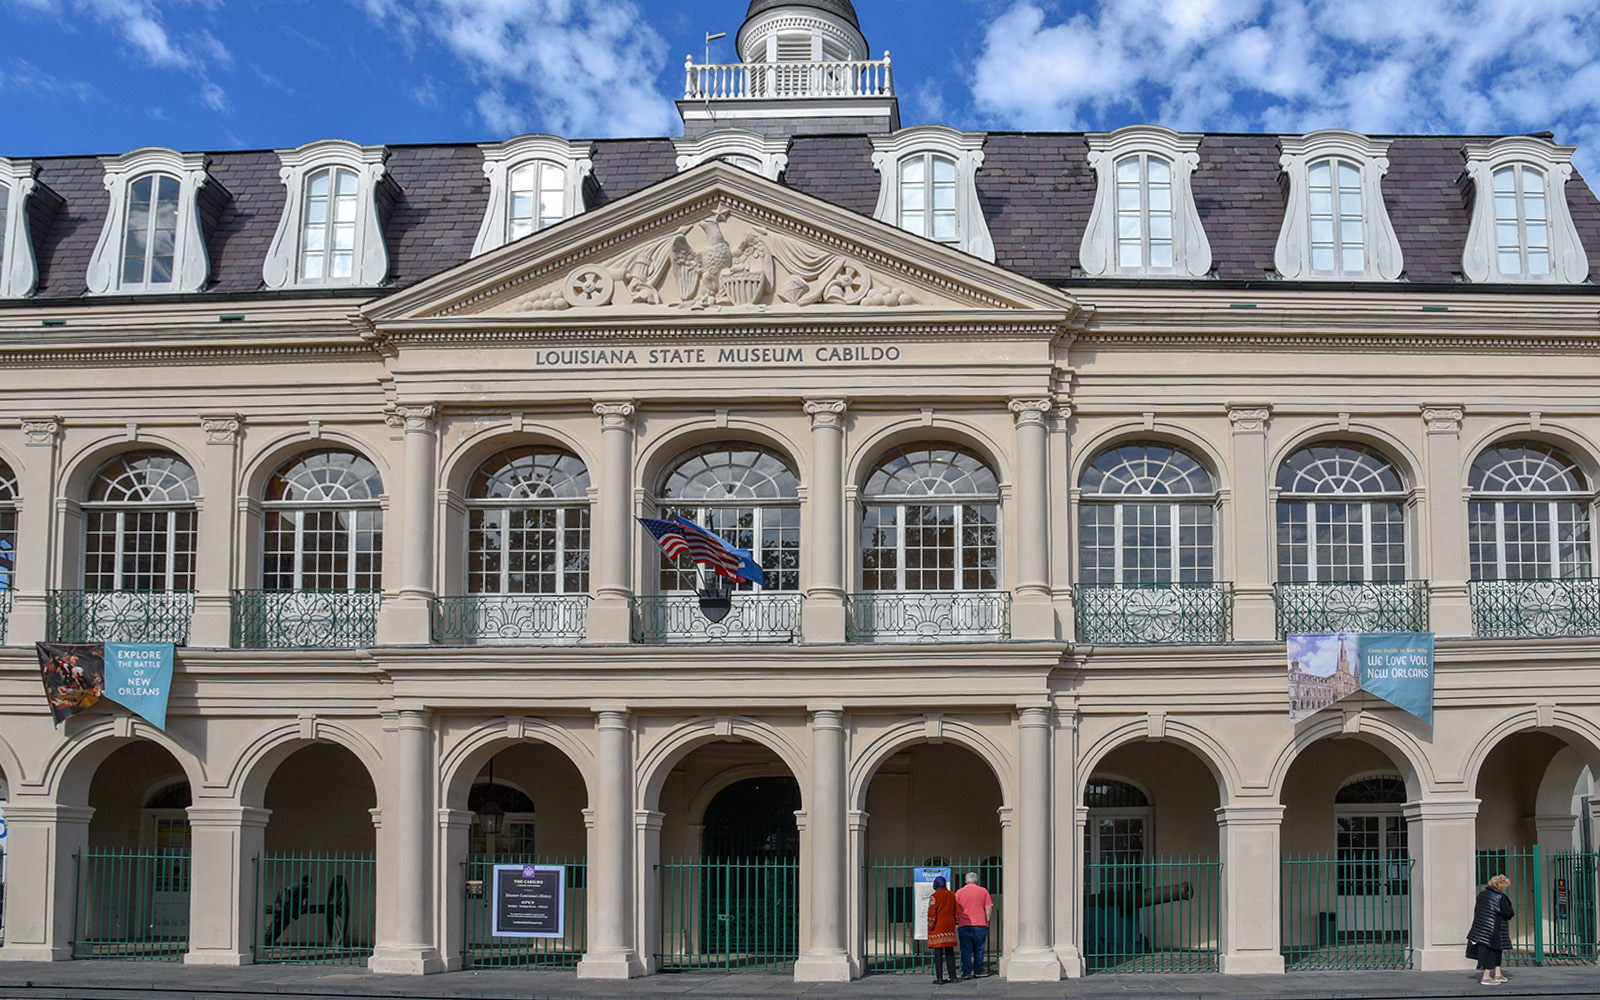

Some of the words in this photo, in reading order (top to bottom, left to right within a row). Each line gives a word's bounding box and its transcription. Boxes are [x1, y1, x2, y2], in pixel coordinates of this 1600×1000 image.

[535, 349, 638, 365] LOUISIANA
[648, 348, 706, 364] STATE
[717, 347, 804, 363] MUSEUM
[815, 346, 901, 362] CABILDO
[117, 650, 162, 660] EXPLORE
[1367, 655, 1383, 666] WE
[1385, 655, 1408, 666] LOVE
[1410, 655, 1428, 666] YOU,
[1367, 667, 1389, 679] NEW
[1391, 667, 1429, 679] ORLEANS
[127, 678, 151, 686] NEW
[117, 687, 160, 696] ORLEANS
